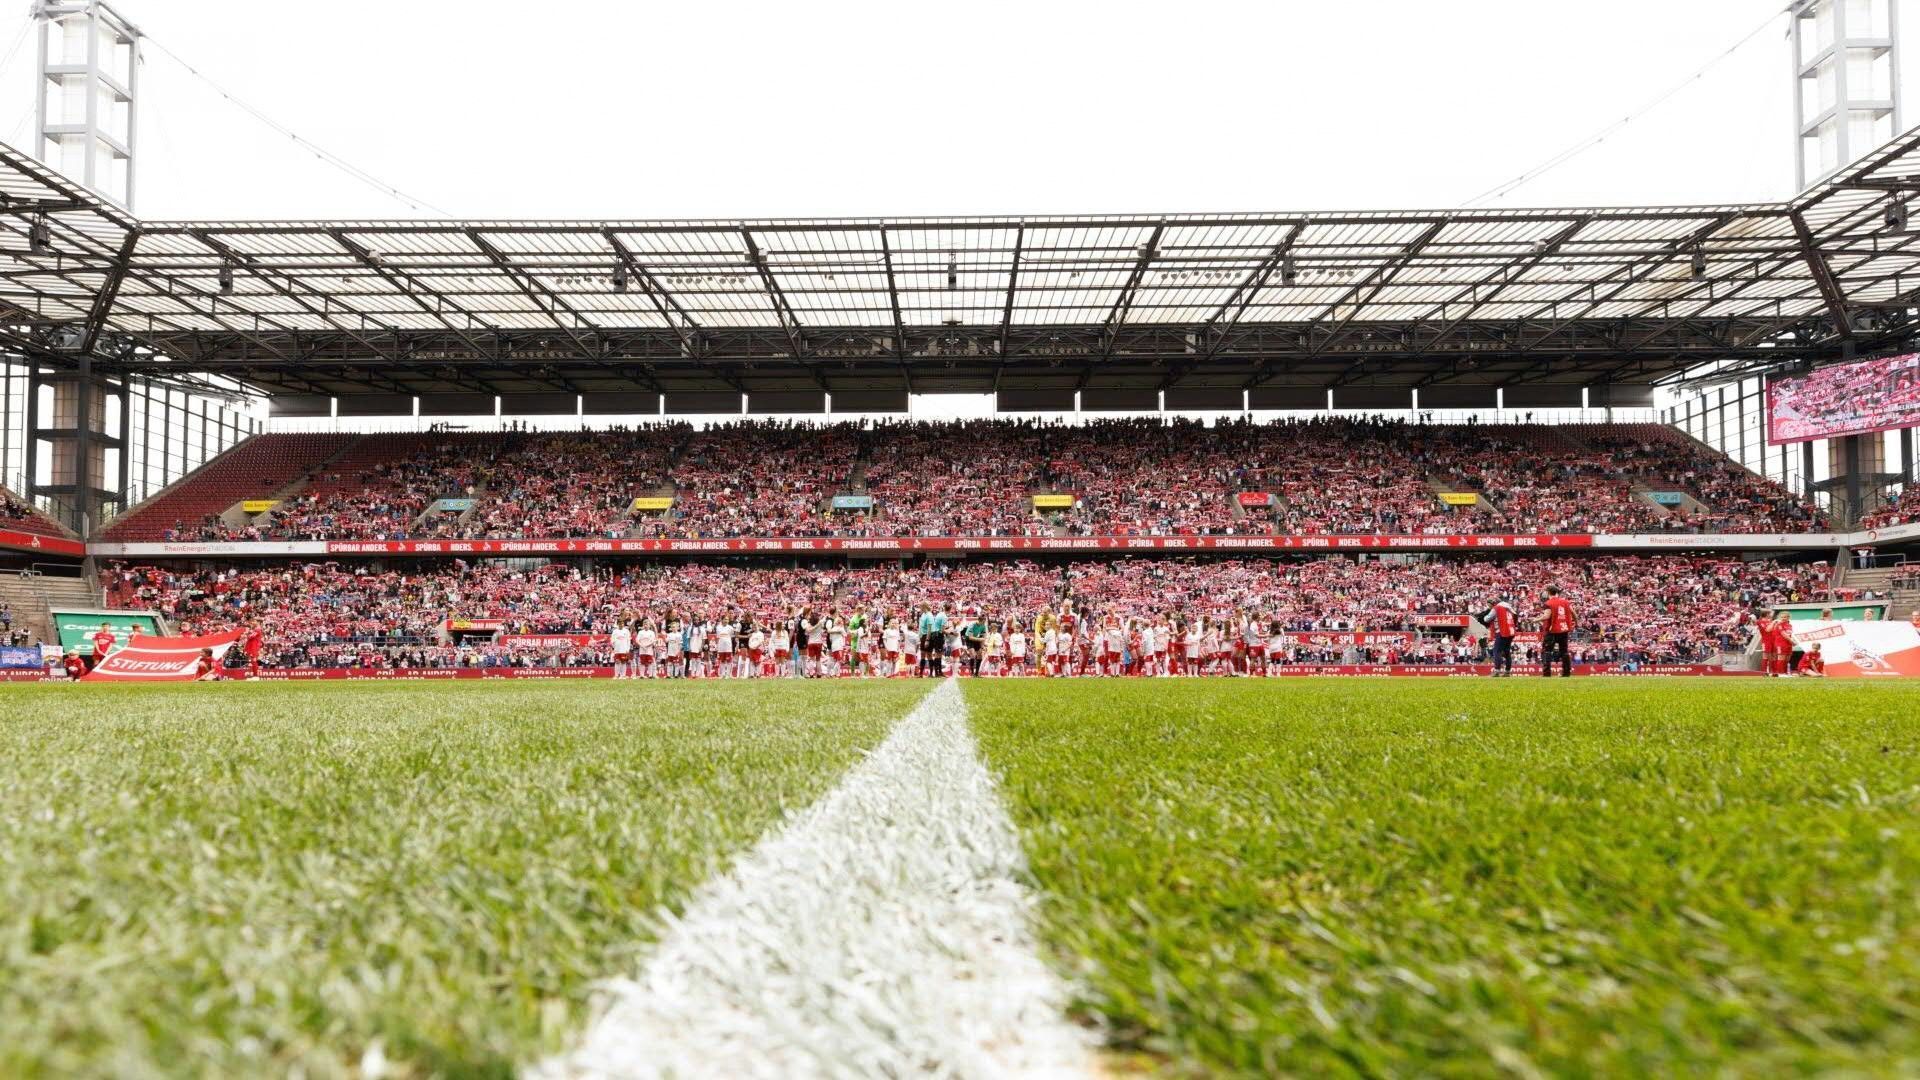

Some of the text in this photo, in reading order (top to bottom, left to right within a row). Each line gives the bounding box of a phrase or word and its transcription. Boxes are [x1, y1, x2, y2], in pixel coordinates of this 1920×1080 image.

[671, 541, 729, 550] SPÜRBAR ANDERS.
[842, 540, 900, 549] SPÜRBAR ANDERS.
[1041, 539, 1100, 548] SPÜRBAR ANDERS.
[1216, 538, 1275, 547] SPÜRBAR ANDERS.
[1390, 537, 1449, 546] SPÜRBAR ANDERS.
[330, 542, 388, 552] SPÜRBAR ANDERS.
[501, 542, 559, 551] SPÜRBAR ANDERS.
[109, 658, 186, 670] STIFTUNG
